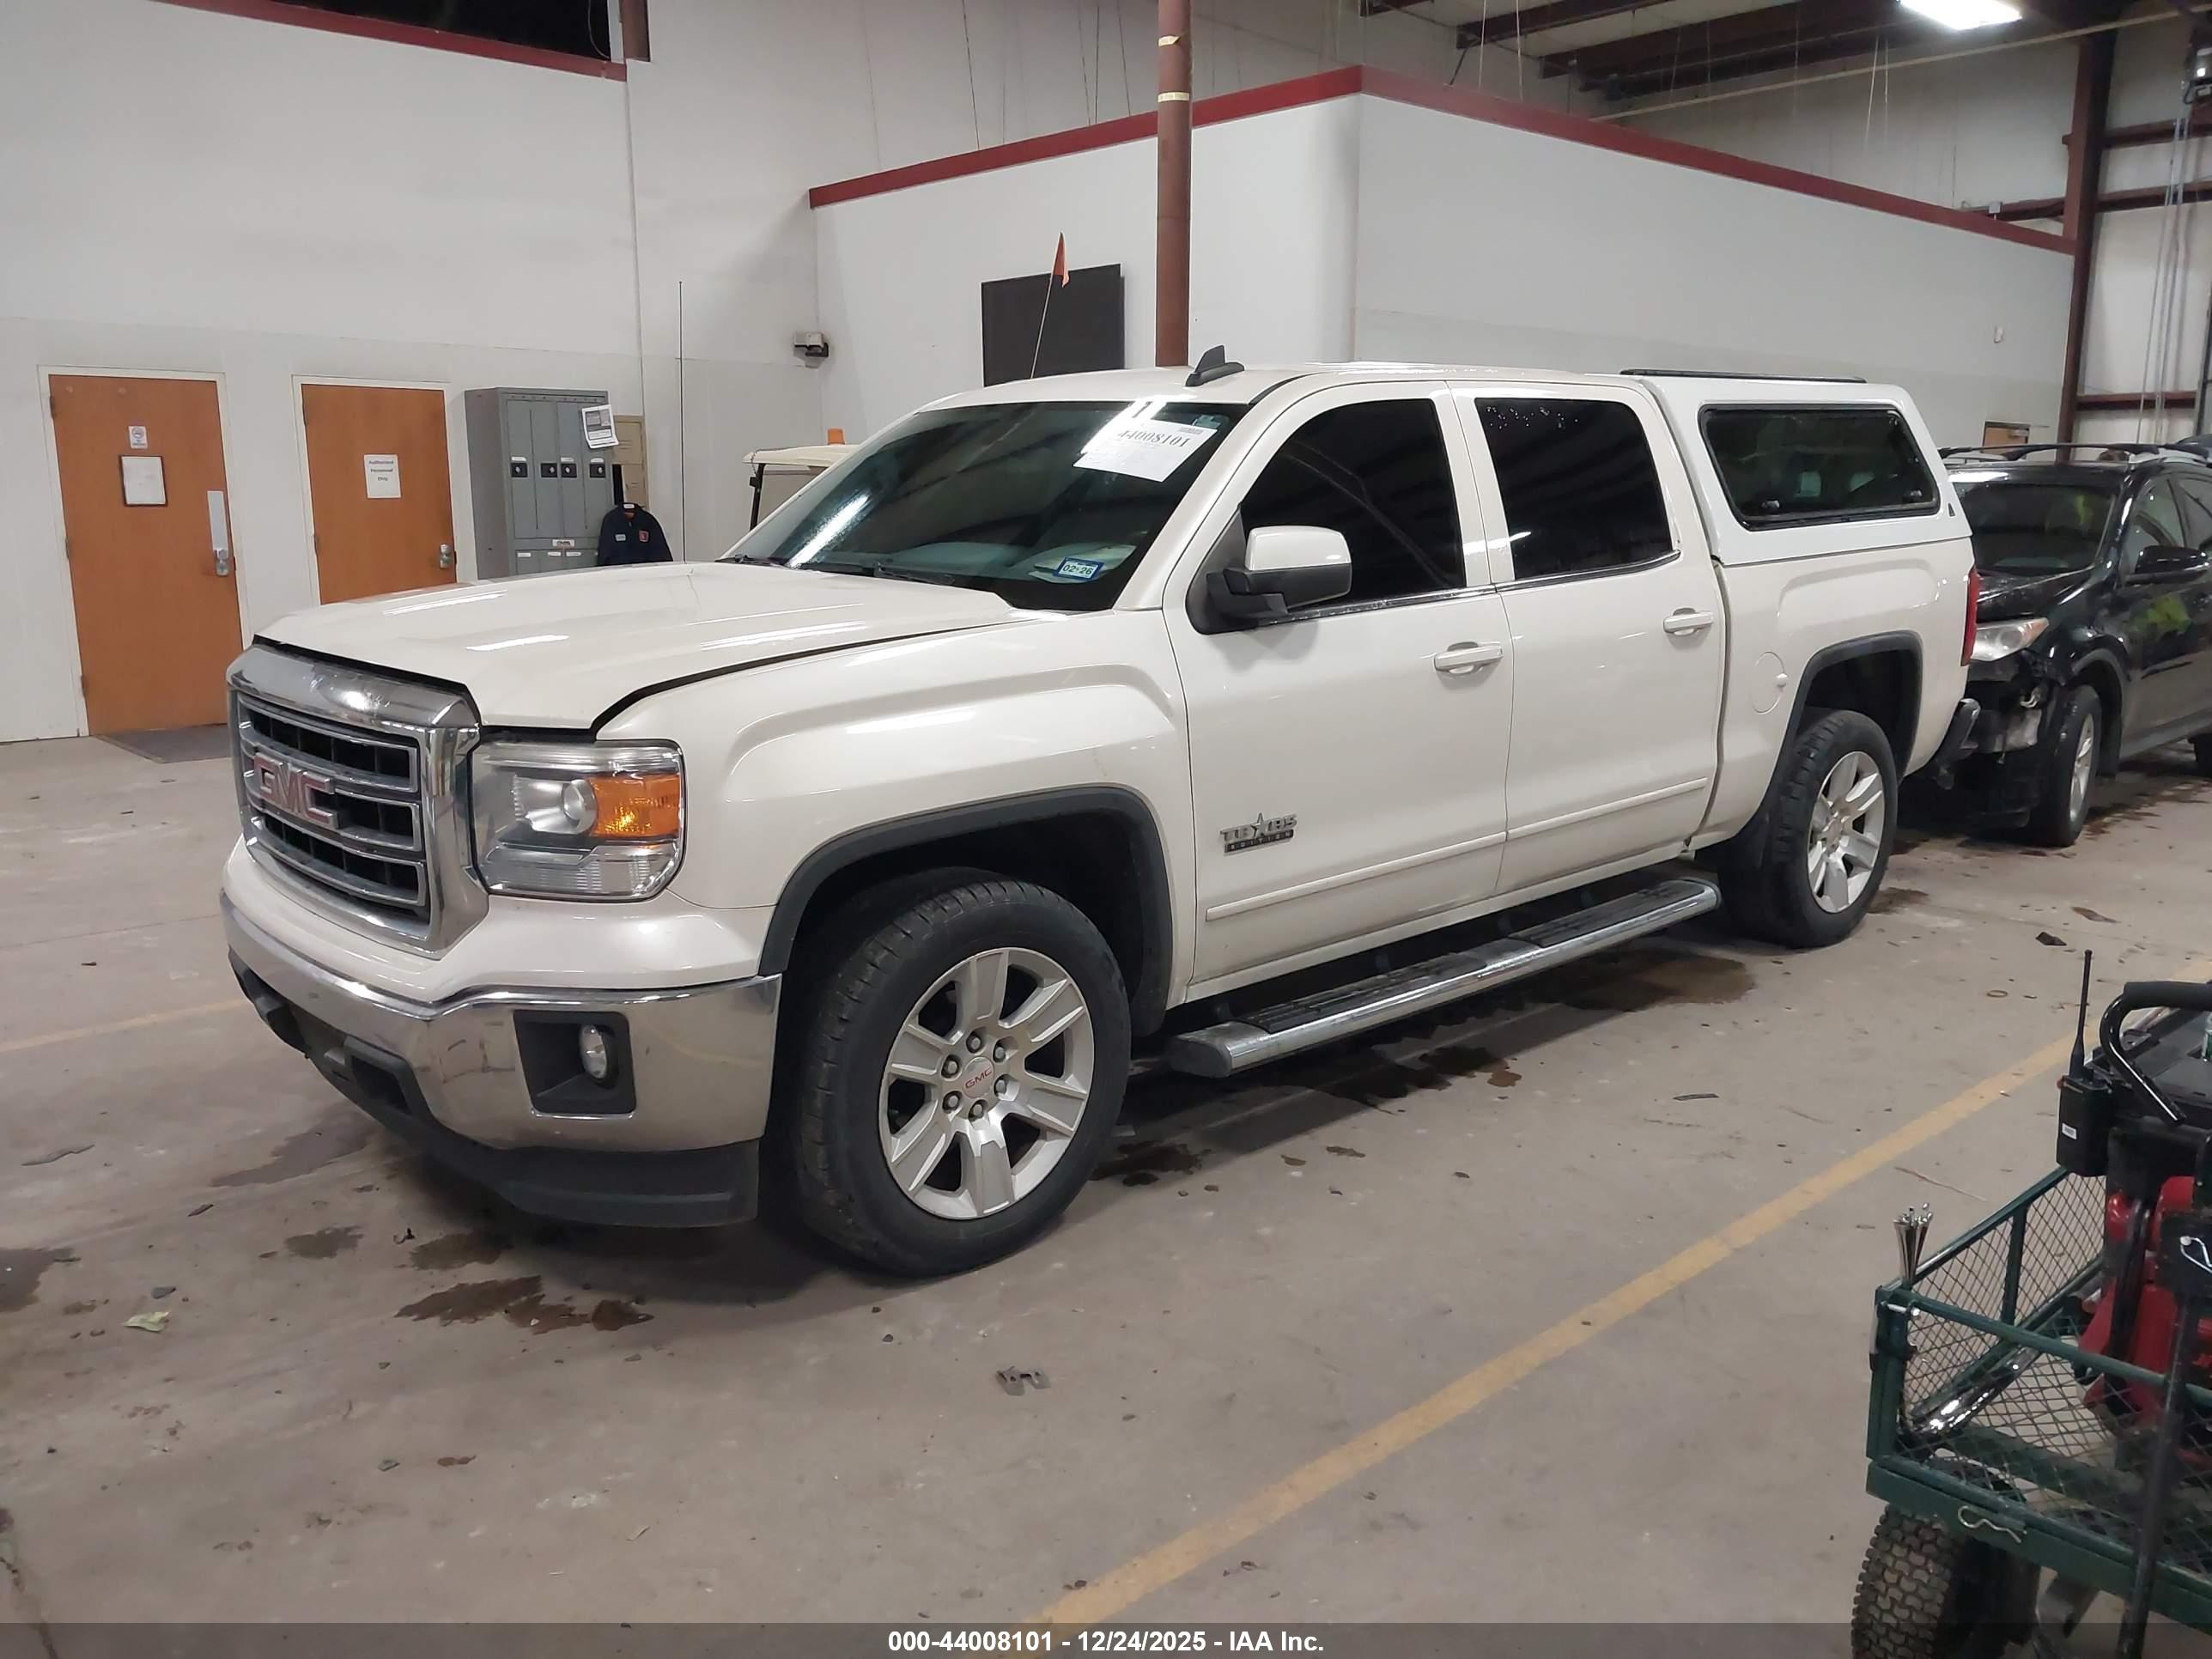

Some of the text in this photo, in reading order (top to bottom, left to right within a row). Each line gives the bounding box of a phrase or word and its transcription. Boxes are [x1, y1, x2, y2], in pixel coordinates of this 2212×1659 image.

[1118, 429, 1191, 447] 44008101
[253, 752, 338, 830] GMC
[1219, 812, 1297, 842] TEXAS
[965, 1068, 992, 1089] GMC
